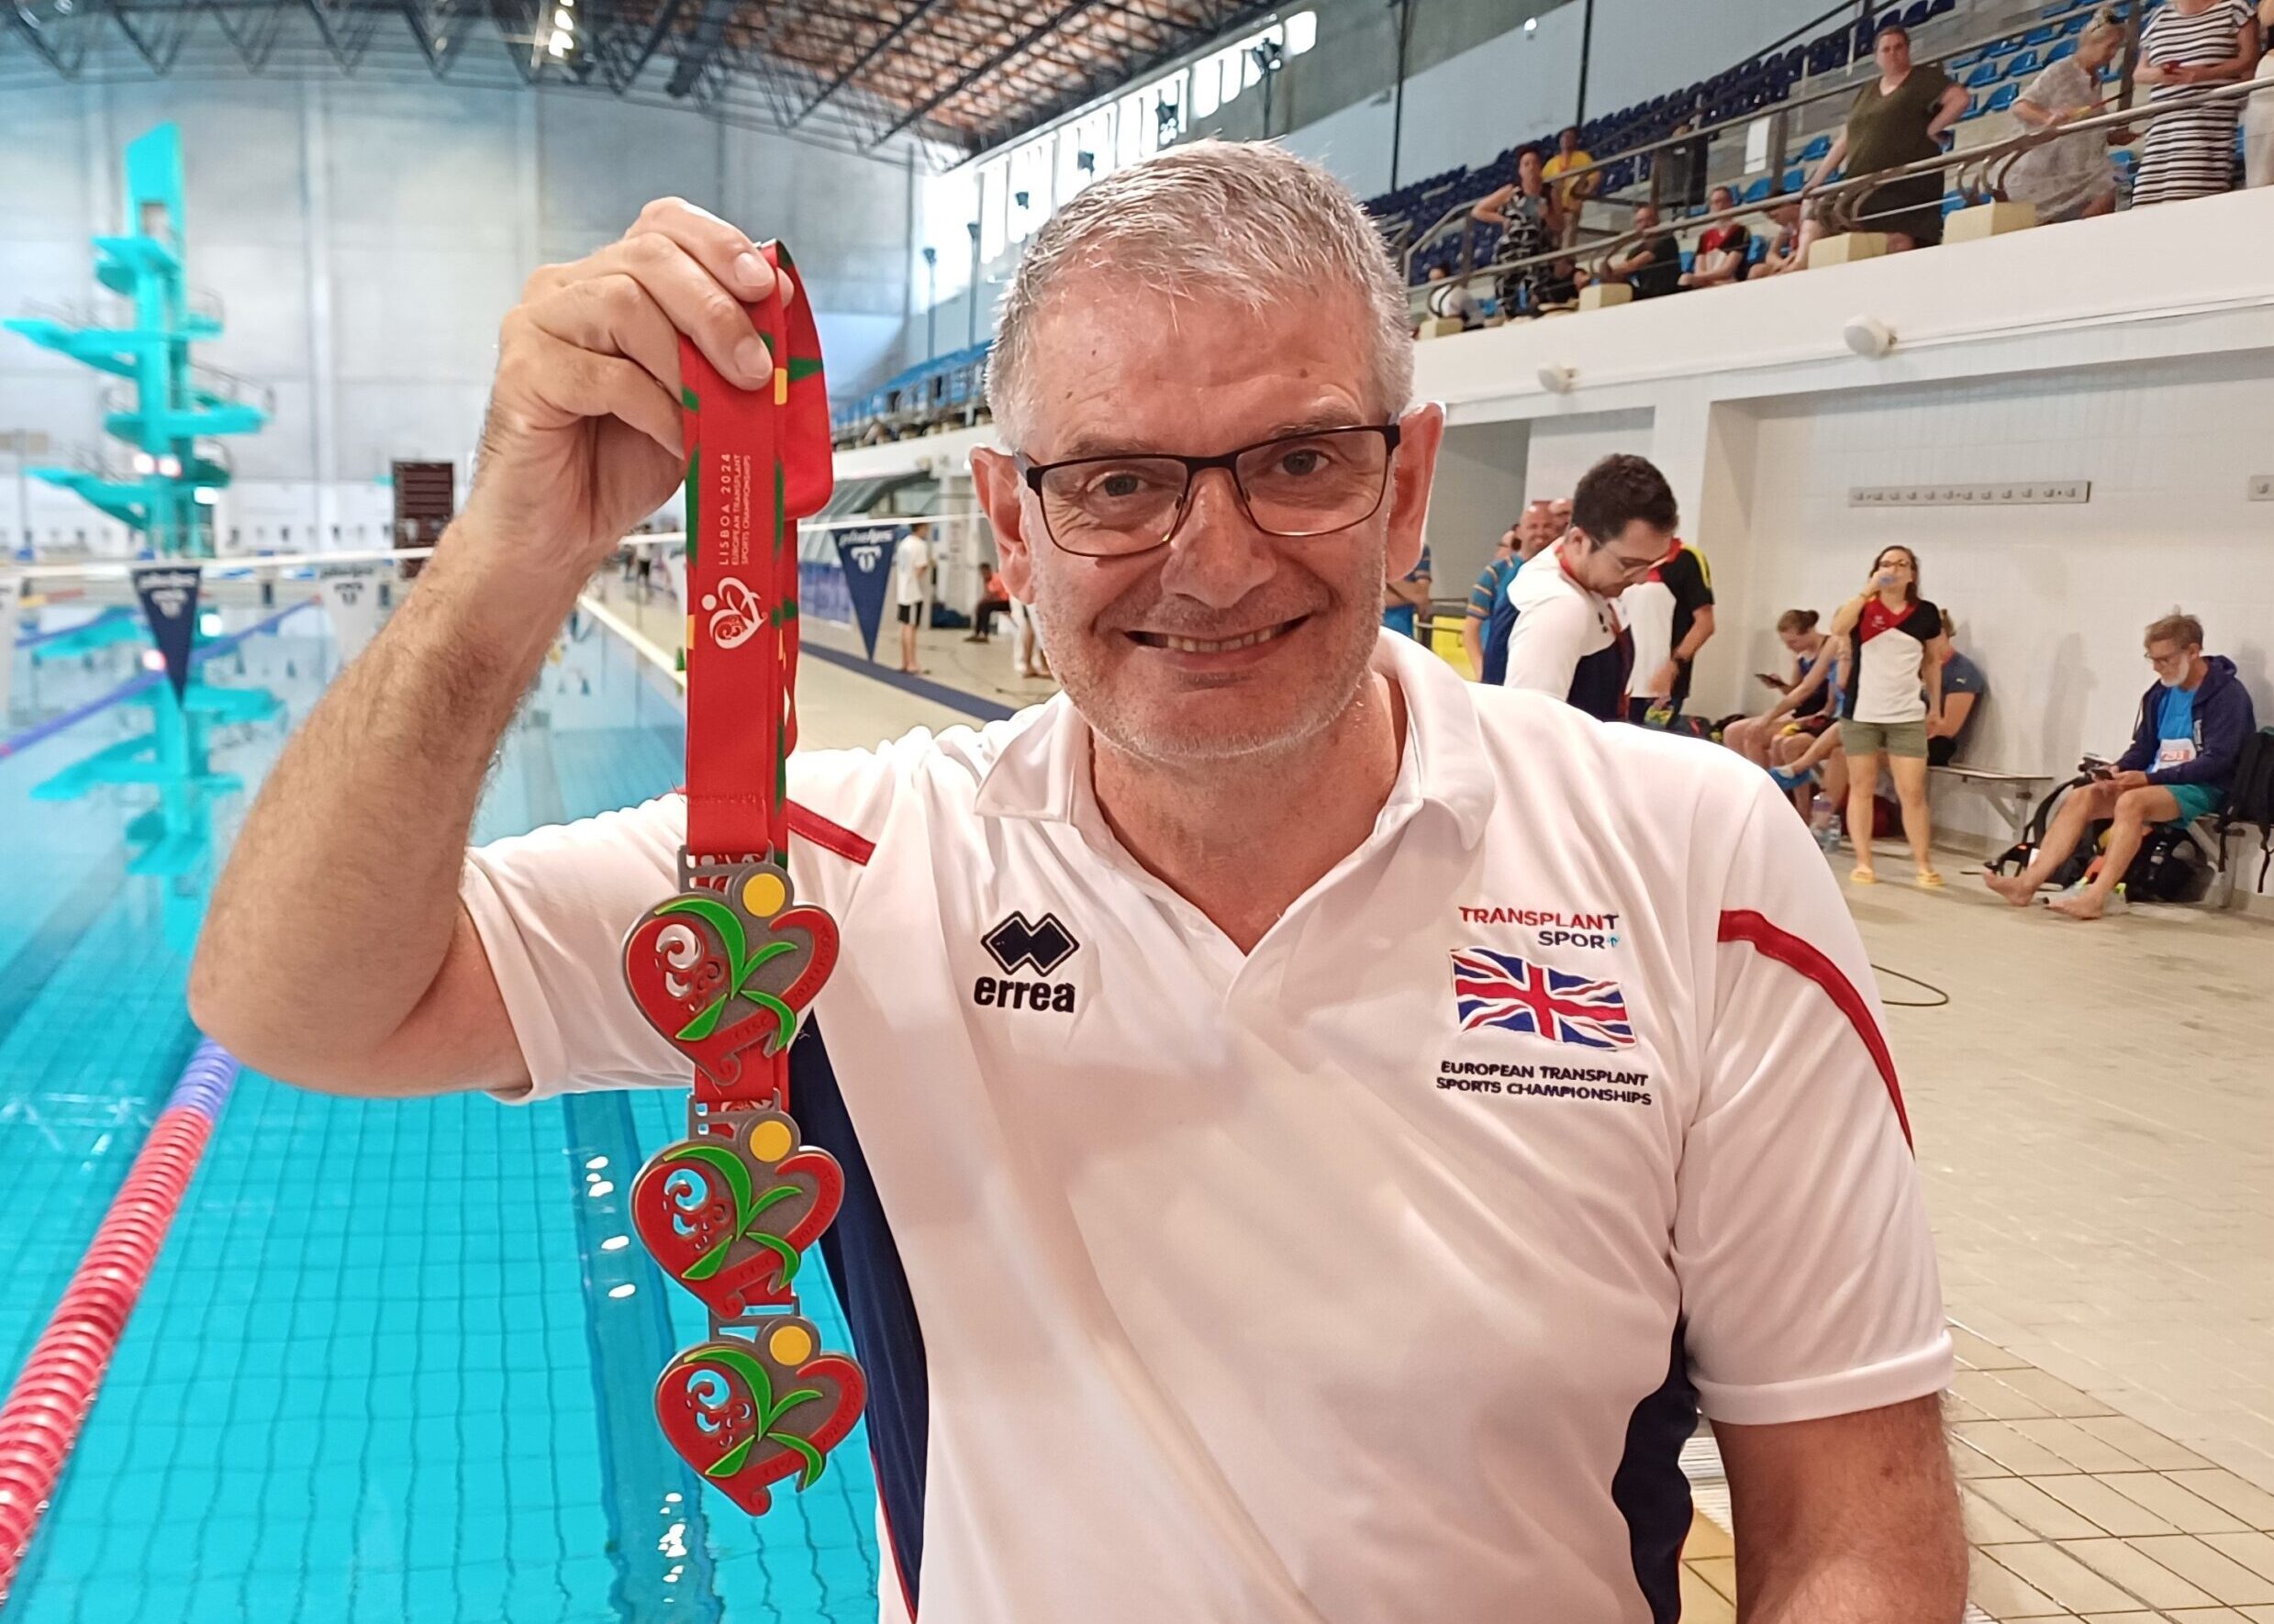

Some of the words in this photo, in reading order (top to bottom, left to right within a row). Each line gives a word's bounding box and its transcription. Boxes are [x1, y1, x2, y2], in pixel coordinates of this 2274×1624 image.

[720, 453, 730, 495] 2024
[732, 454, 741, 513] TRANSPLANT
[741, 455, 752, 529] CHAMPIONSHIPS
[719, 504, 730, 565] LISBOA
[732, 515, 741, 565] EUROPEAN
[741, 531, 750, 565] SPORTS
[1457, 906, 1620, 930] TRANSPLANT
[1436, 1077, 1502, 1093] SPORTS
[1506, 1083, 1652, 1106] CHAMPIONSHIPS
[1441, 1061, 1534, 1078] EUROPEAN
[1539, 1065, 1648, 1086] TRANSPLANT
